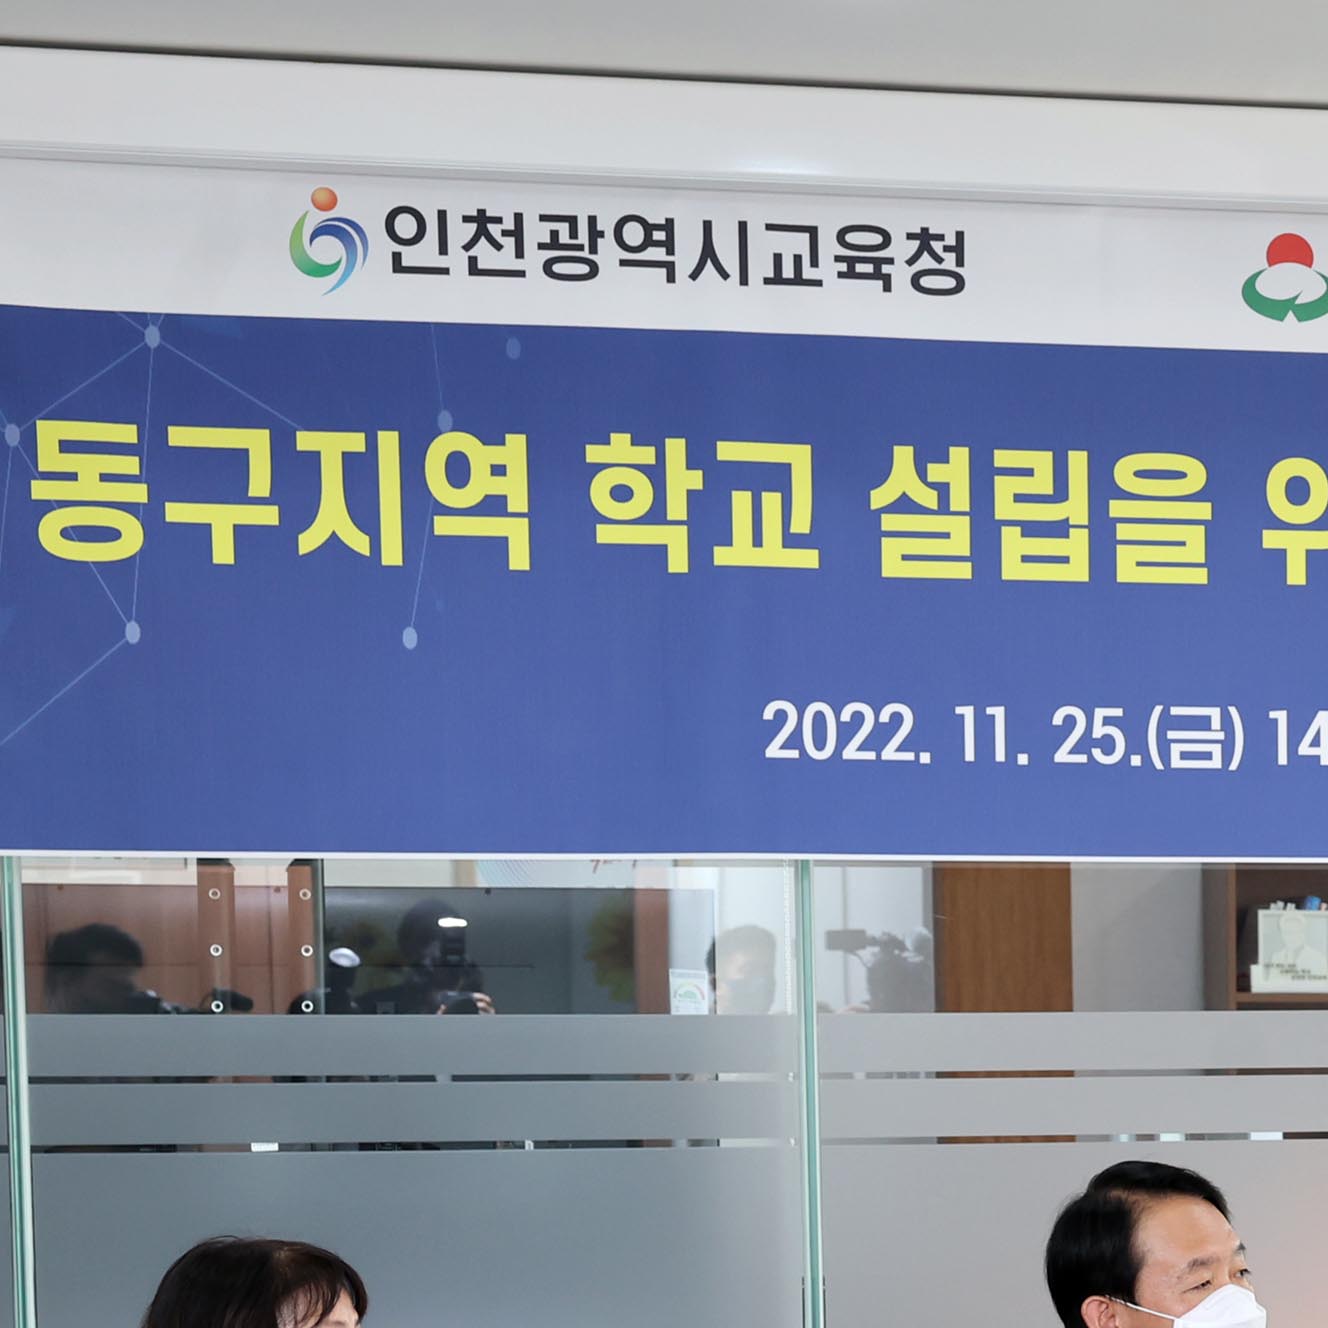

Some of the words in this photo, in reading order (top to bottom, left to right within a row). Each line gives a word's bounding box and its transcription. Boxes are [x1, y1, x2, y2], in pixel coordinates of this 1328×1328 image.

[384, 205, 966, 297] 인천광역시교육청
[30, 420, 531, 570] 동구지역
[585, 433, 820, 573] 학교
[870, 446, 1213, 584] 설립을
[762, 699, 931, 764] 2022.
[955, 704, 1030, 766] 11.
[1051, 704, 1244, 771] 25.(금)
